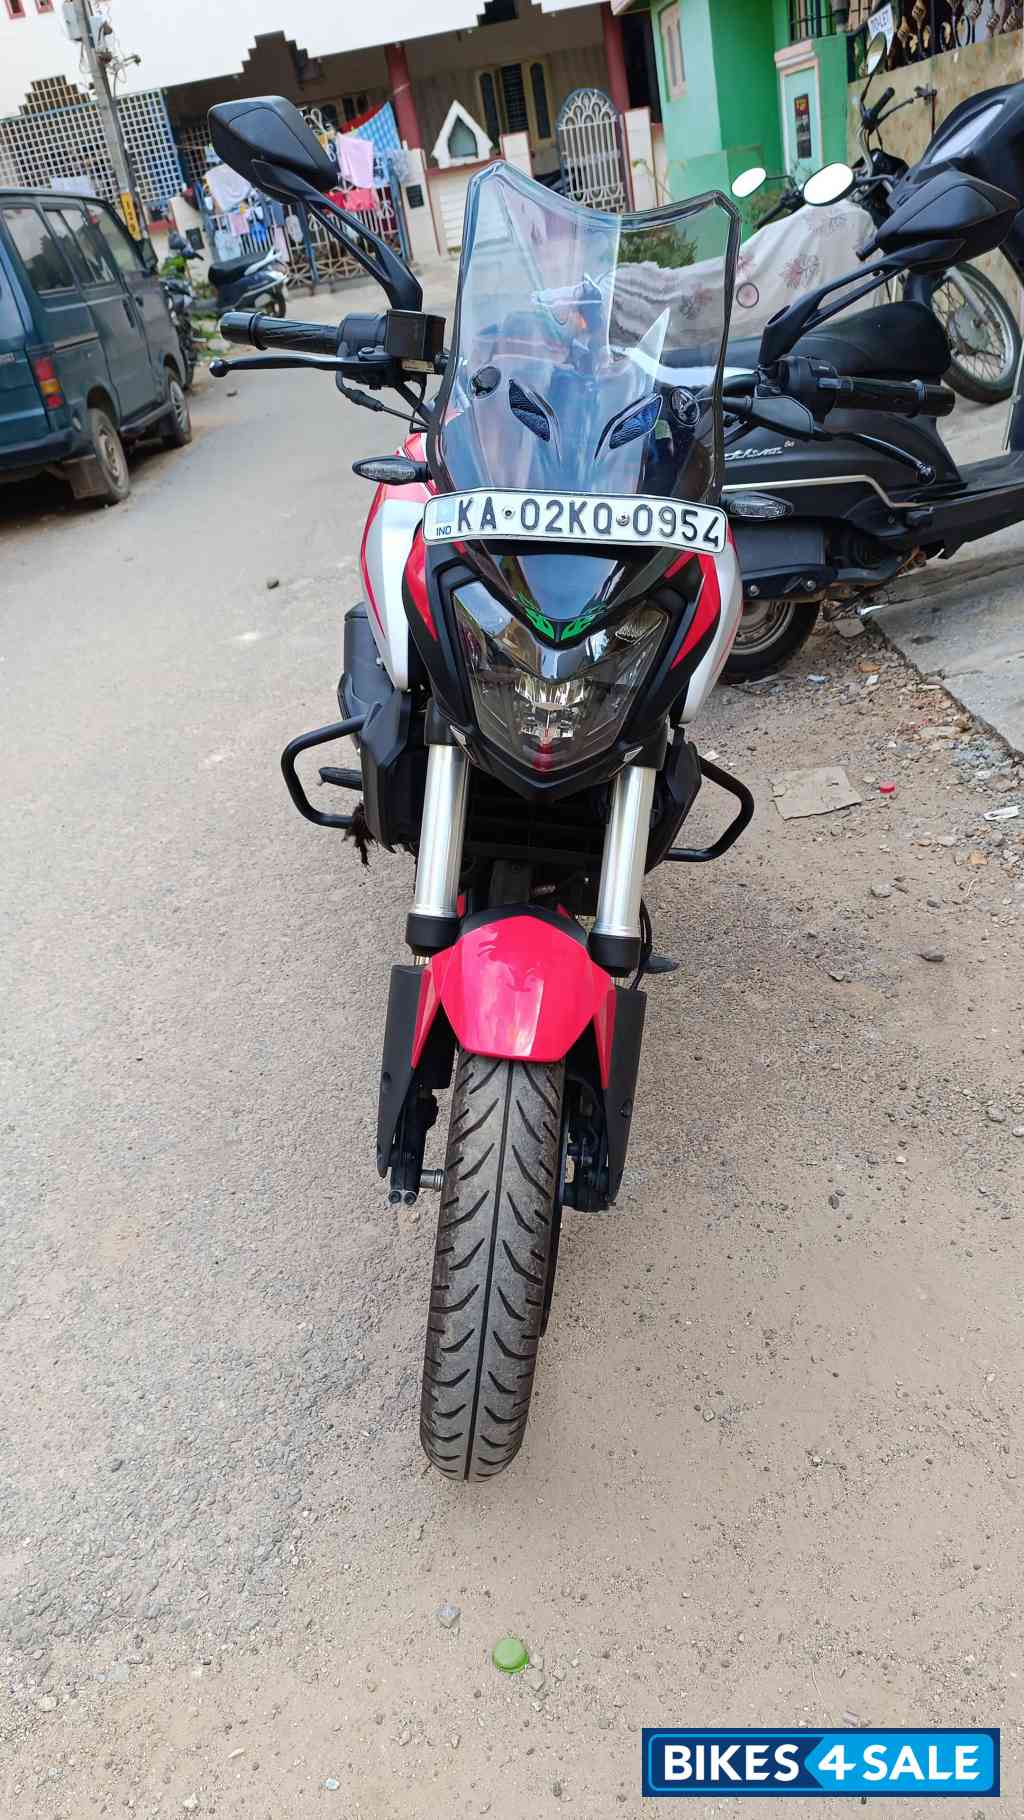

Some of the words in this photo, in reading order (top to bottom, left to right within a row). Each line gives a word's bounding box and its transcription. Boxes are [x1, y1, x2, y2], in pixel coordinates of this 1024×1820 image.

[436, 525, 452, 536] IND
[458, 496, 497, 531] KA
[520, 498, 613, 536] 02KQ
[632, 503, 719, 548] 0954
